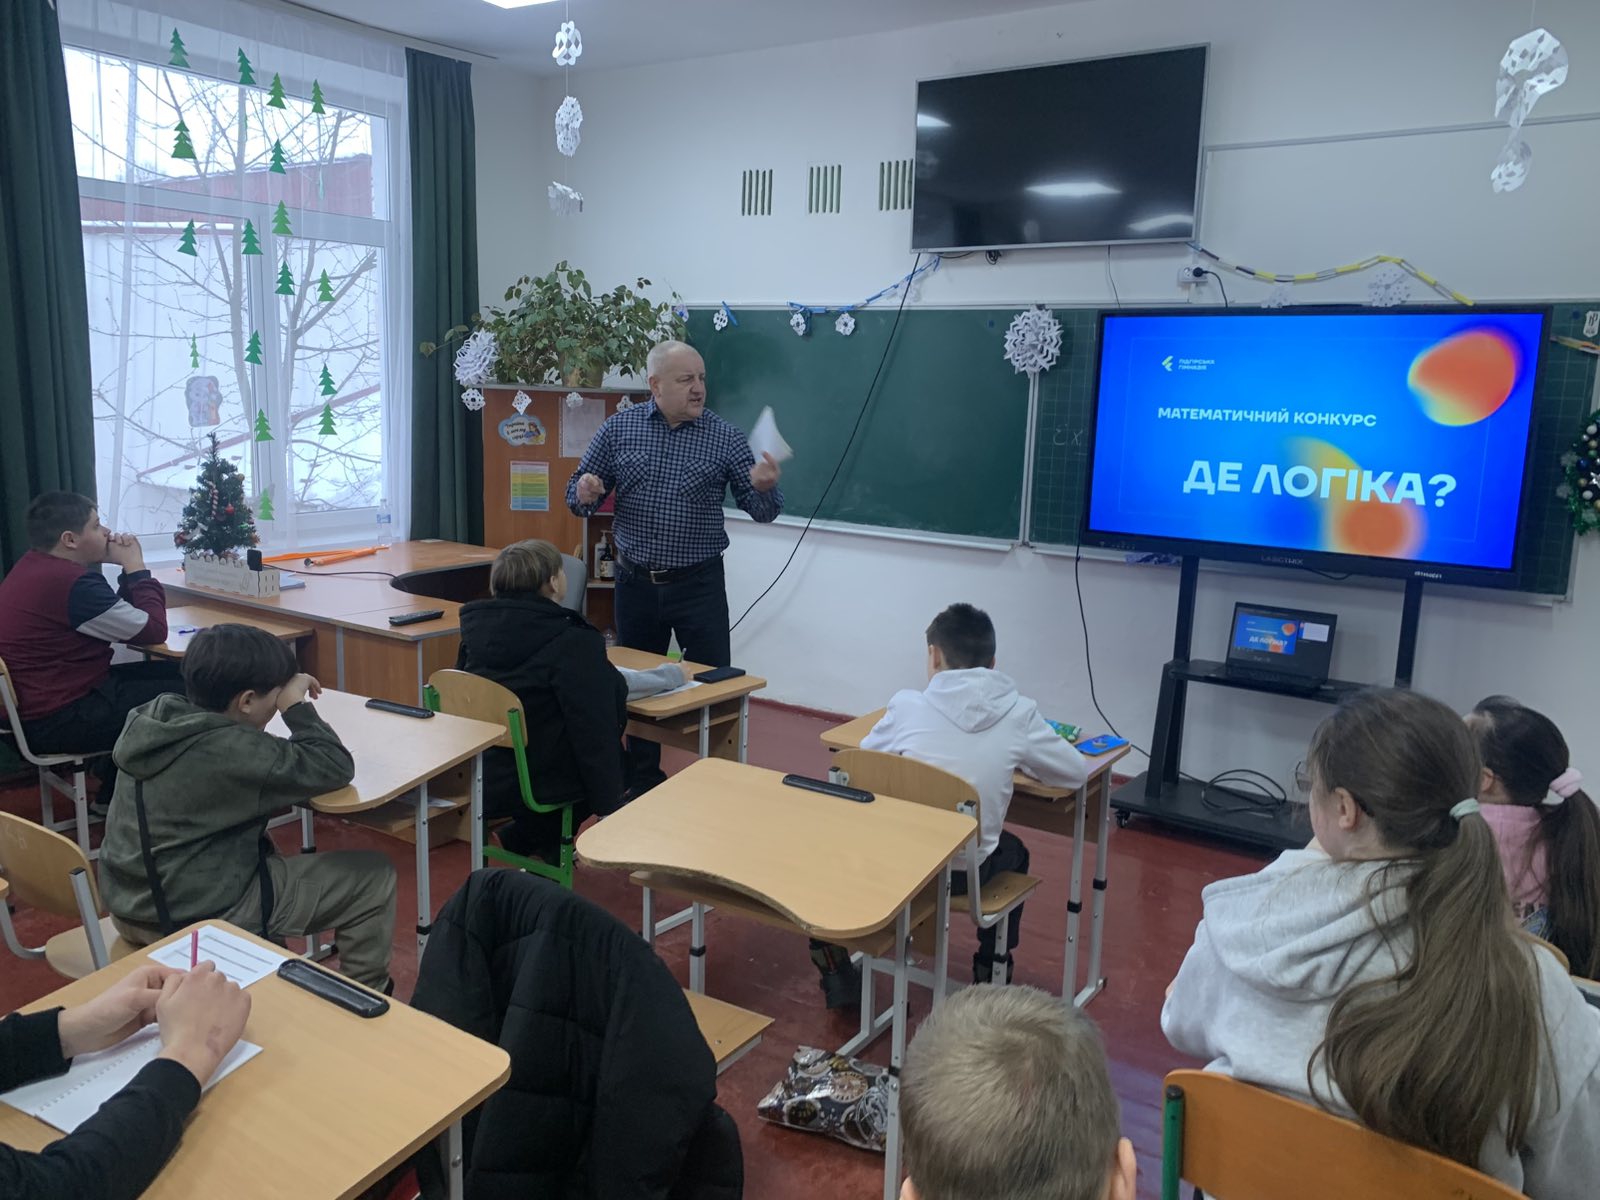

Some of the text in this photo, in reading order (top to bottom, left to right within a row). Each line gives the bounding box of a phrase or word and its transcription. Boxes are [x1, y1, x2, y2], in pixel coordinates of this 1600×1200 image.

[1157, 407, 1377, 427] МАТЕМАТИЧНИЙ КОНКУРС
[1182, 459, 1457, 508] ДЕ ЛОГІКА?
